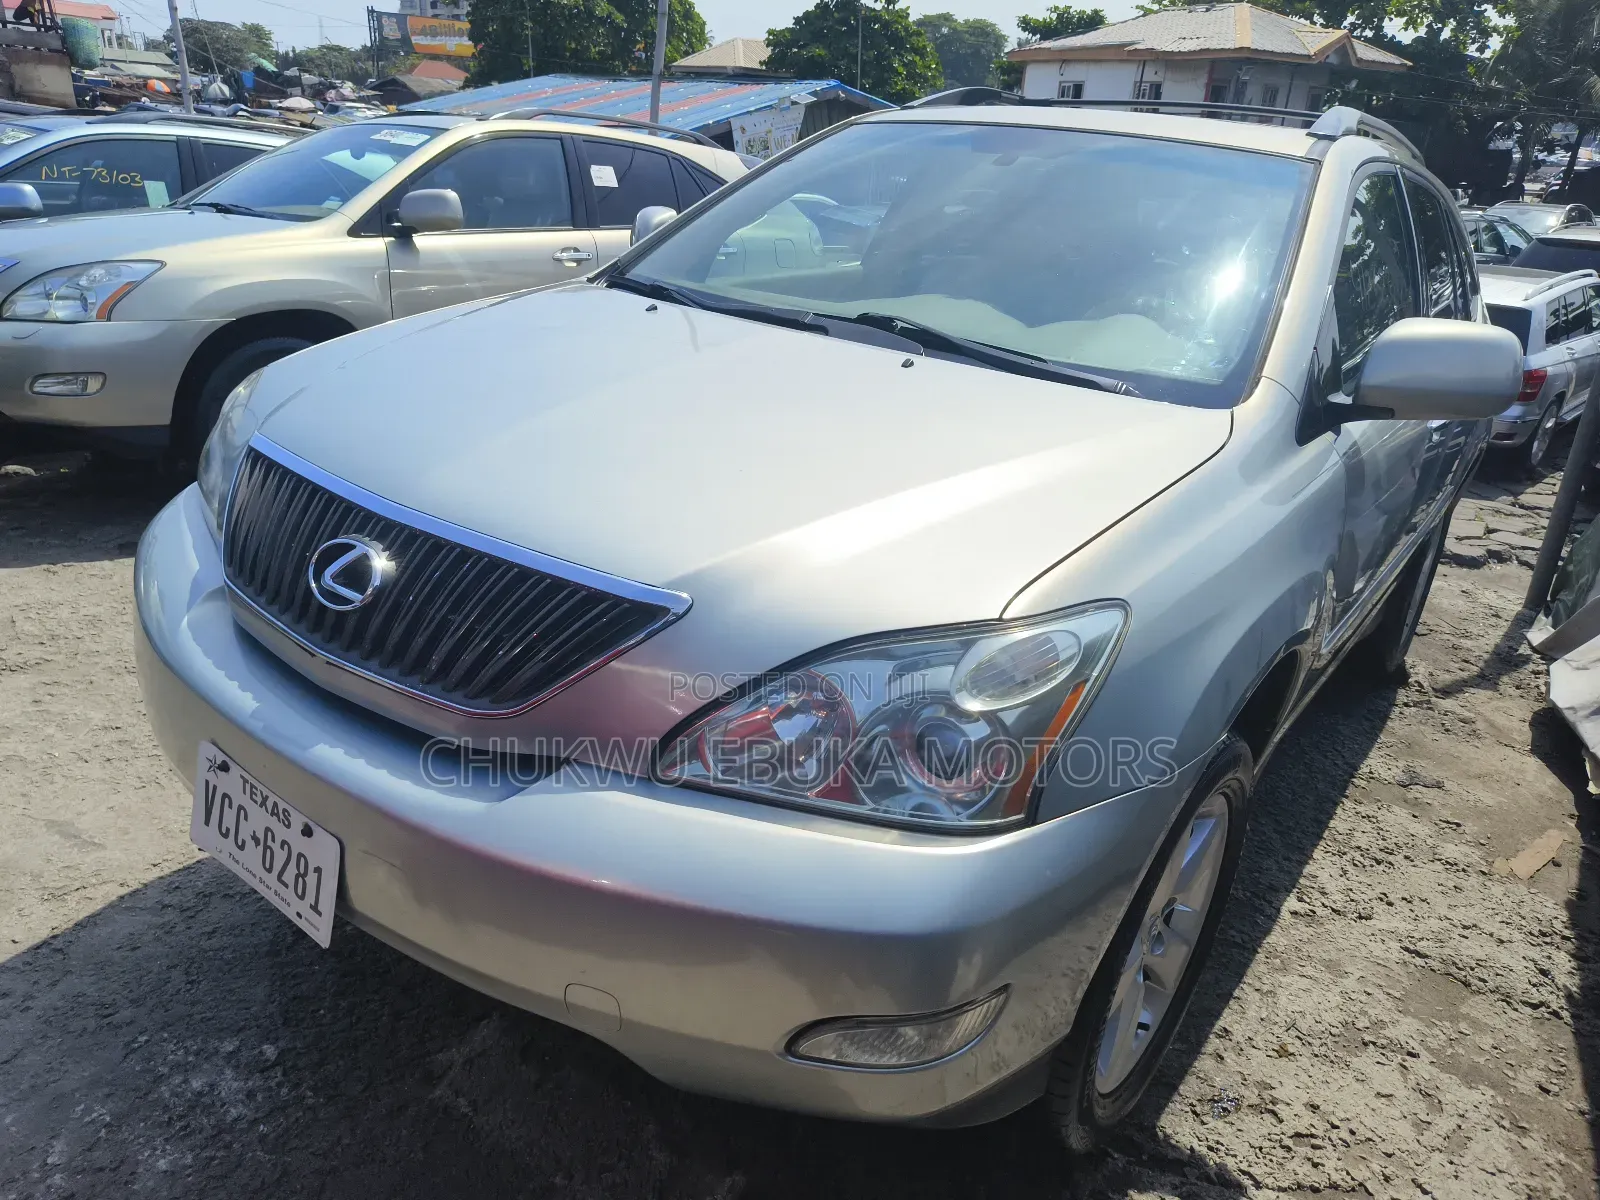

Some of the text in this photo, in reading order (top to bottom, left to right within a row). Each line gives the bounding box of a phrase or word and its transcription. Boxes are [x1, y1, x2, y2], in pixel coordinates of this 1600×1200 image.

[41, 164, 144, 187] NT-73103
[239, 773, 292, 830] TEXAS
[228, 851, 291, 908] The Lone Star State
